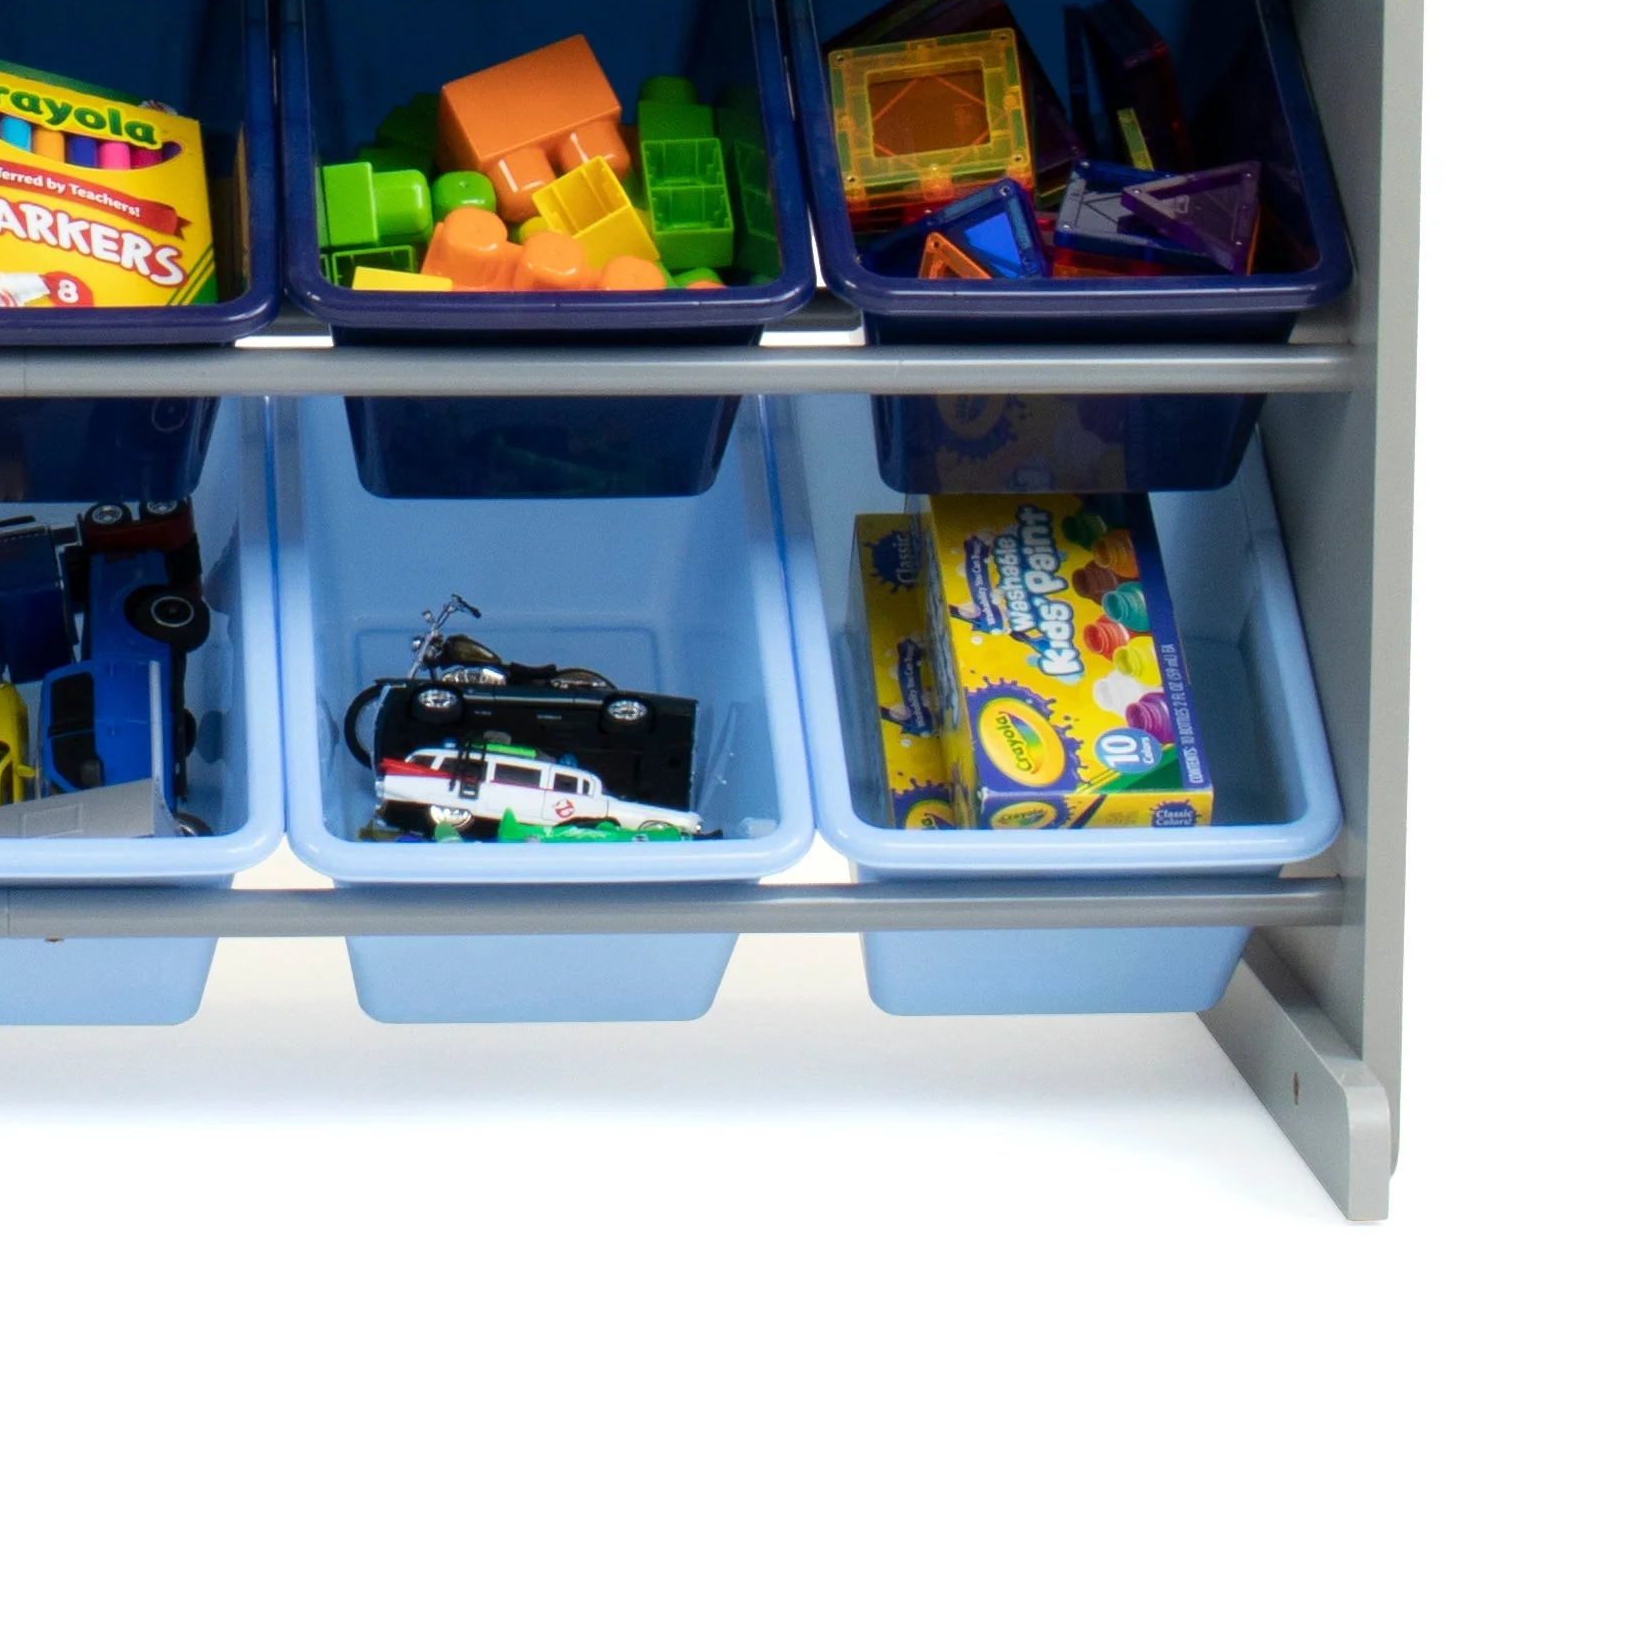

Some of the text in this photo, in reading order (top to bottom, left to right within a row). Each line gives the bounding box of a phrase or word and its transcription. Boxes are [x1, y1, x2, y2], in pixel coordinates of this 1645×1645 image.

[46, 175, 66, 195] by
[68, 182, 141, 218] Teachers!
[58, 279, 79, 303] 8
[1020, 505, 1068, 593] Paint
[997, 536, 1035, 630] Washable
[996, 715, 1033, 773] Crayola
[1100, 734, 1140, 768] 10
[1155, 809, 1193, 819] Classic
